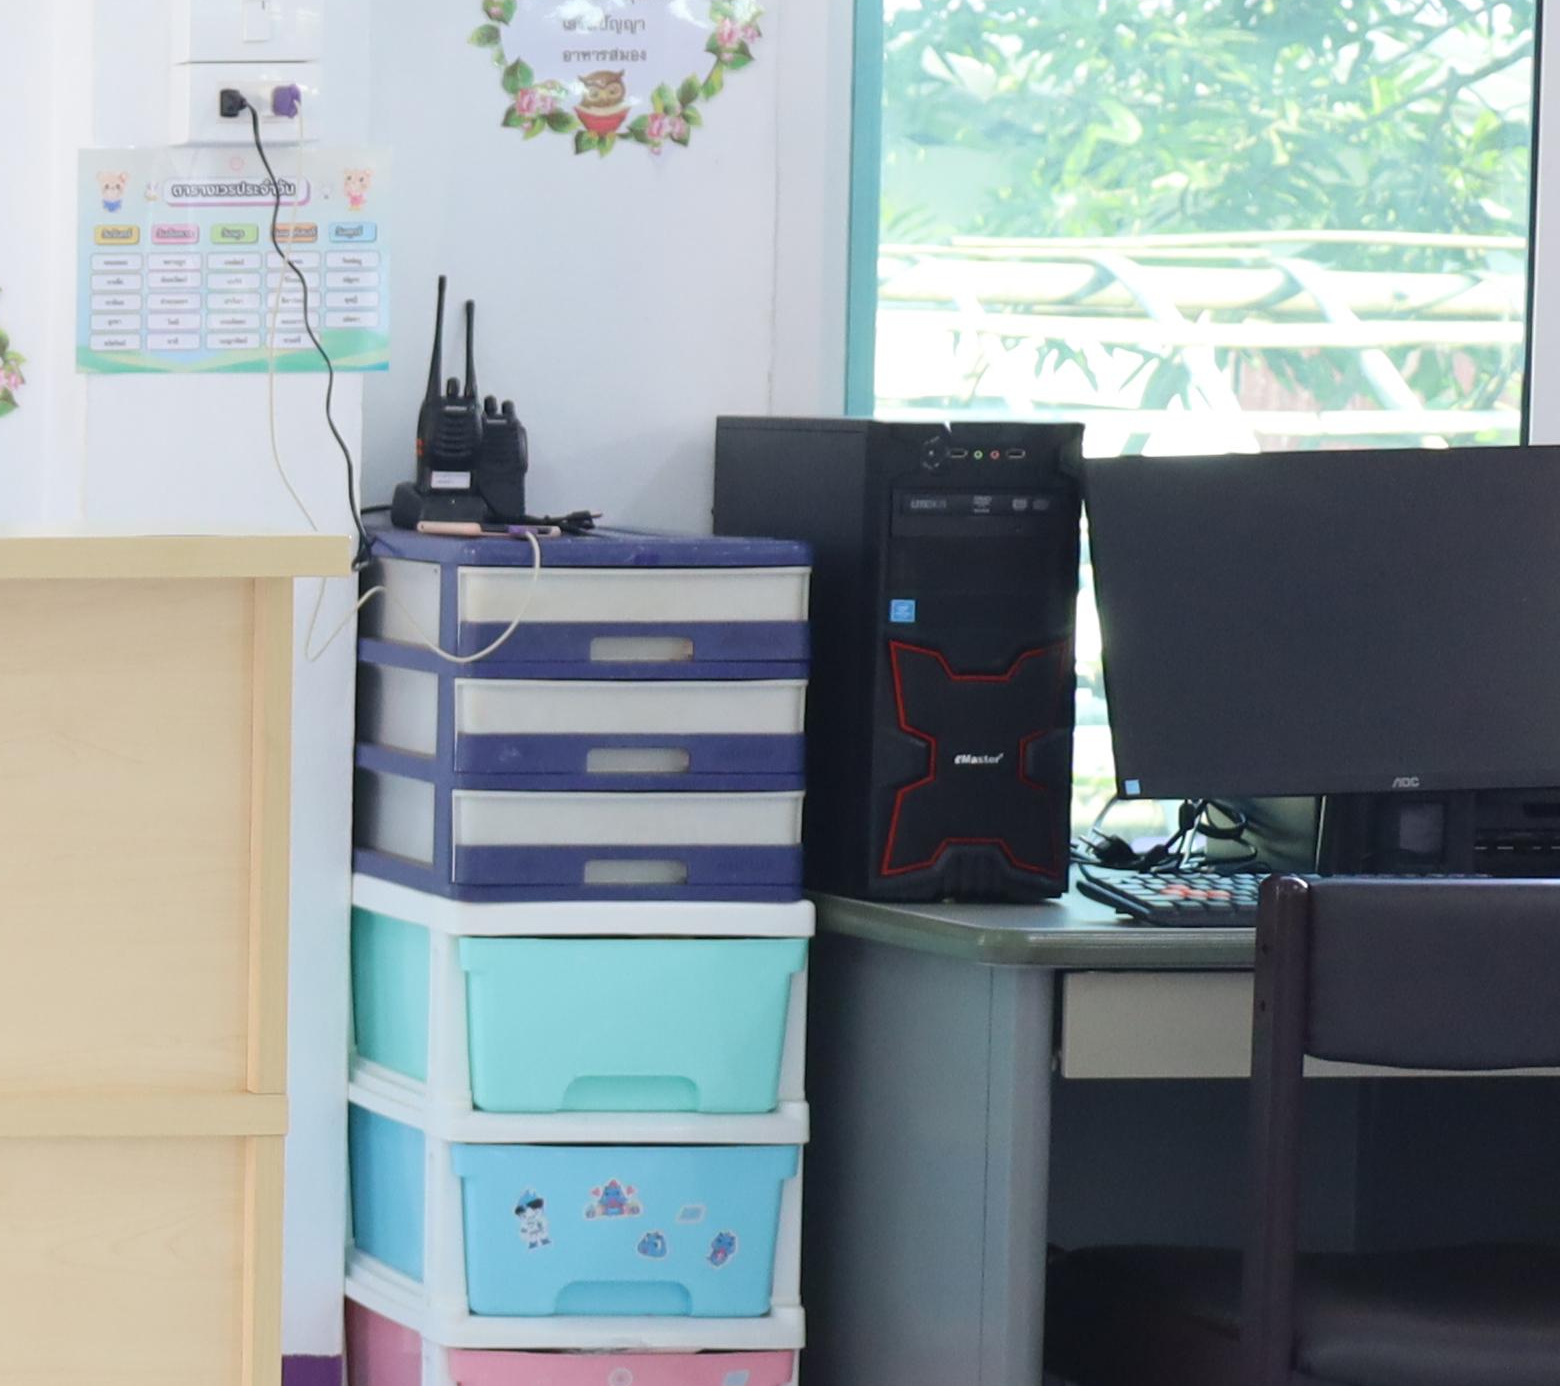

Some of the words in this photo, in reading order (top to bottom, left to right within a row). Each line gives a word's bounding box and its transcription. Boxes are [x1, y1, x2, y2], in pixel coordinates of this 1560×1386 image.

[563, 49, 647, 62] อาหารสมอง
[1392, 776, 1420, 788] AOC
